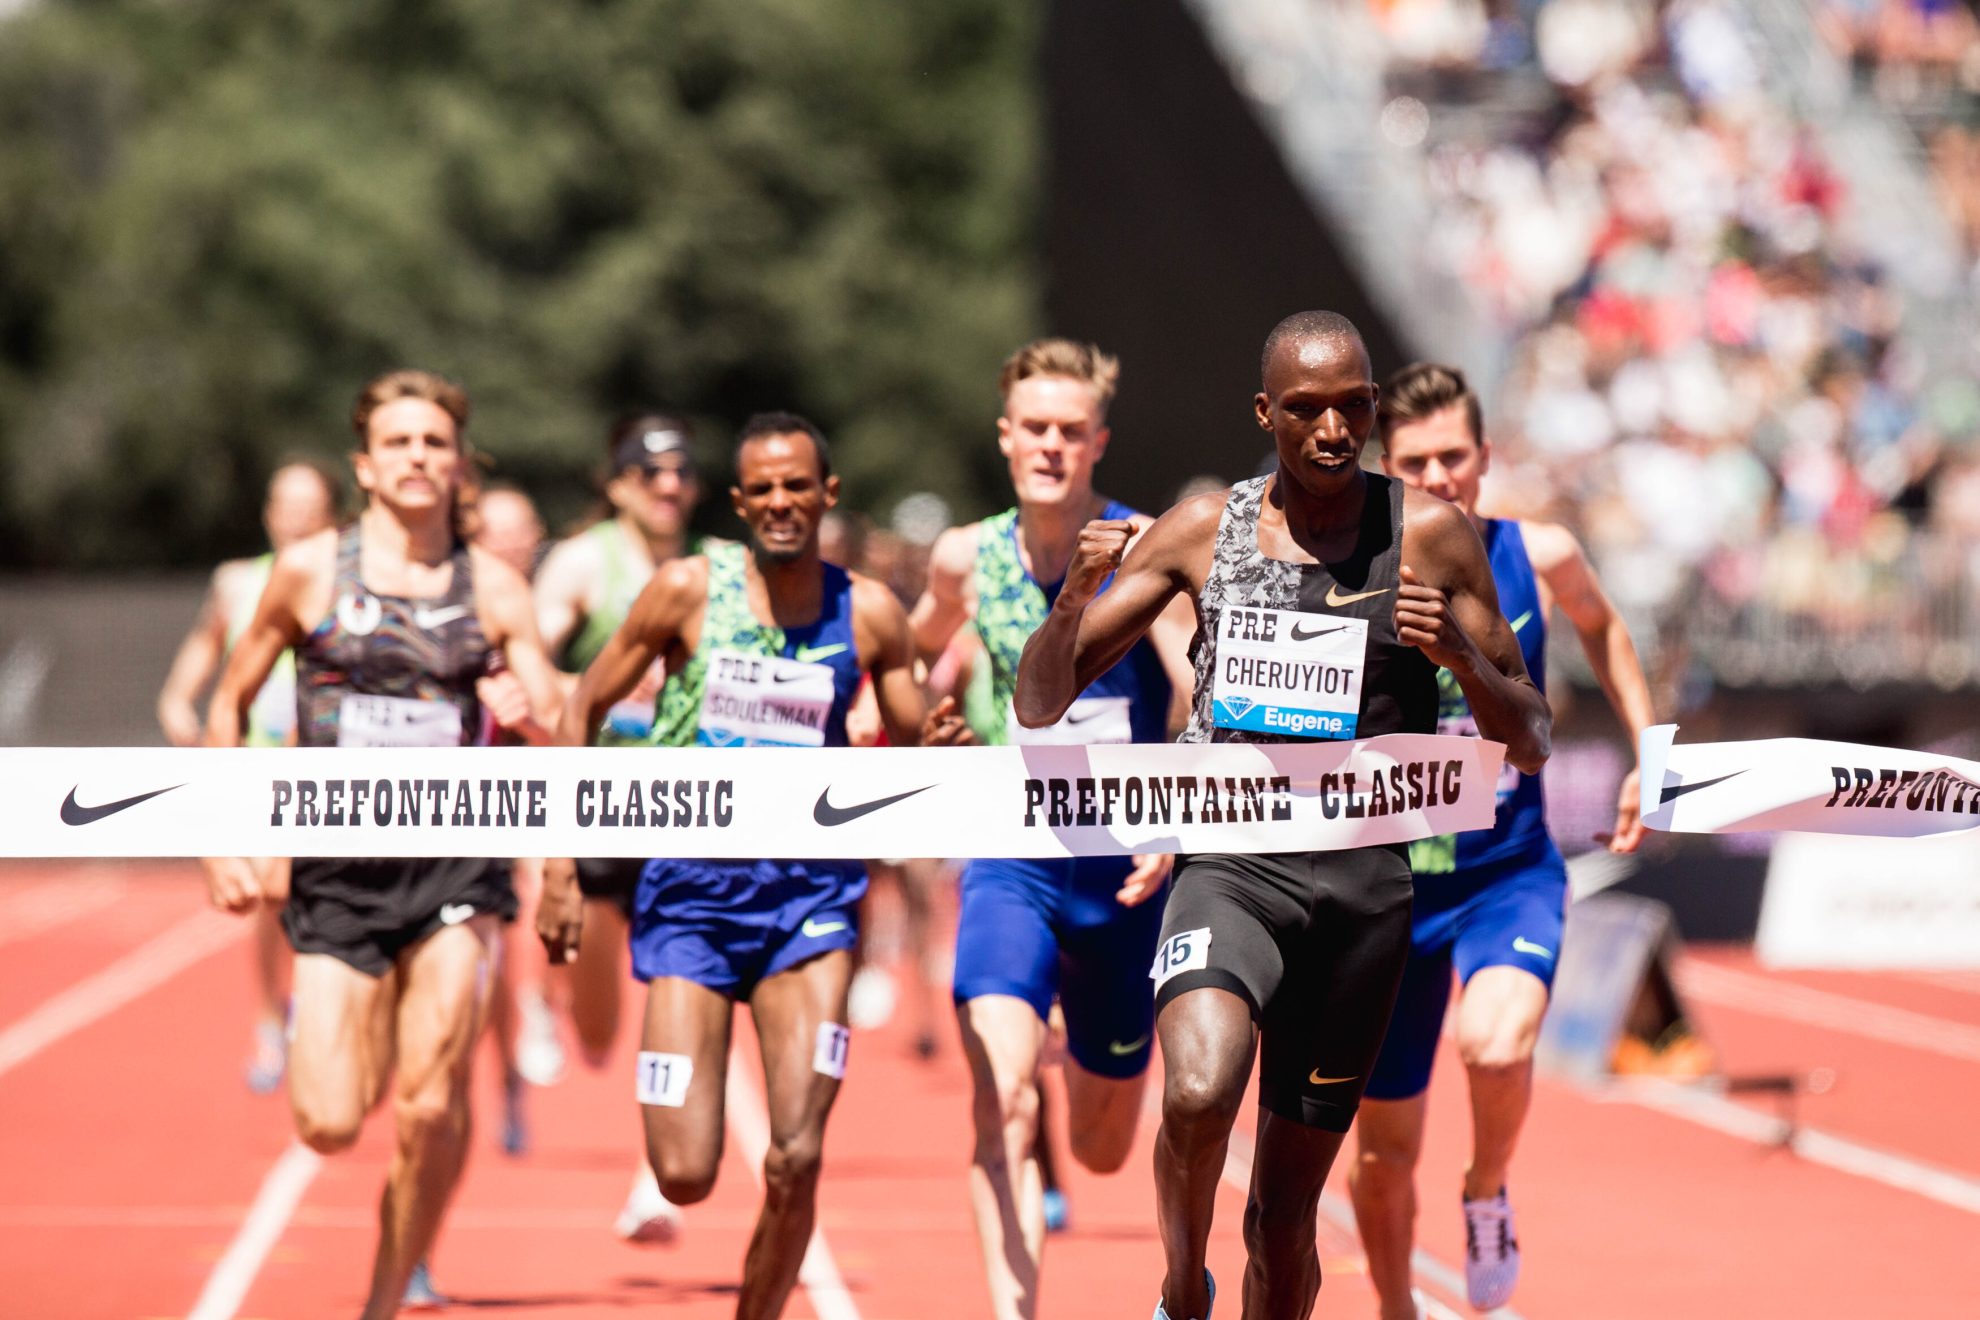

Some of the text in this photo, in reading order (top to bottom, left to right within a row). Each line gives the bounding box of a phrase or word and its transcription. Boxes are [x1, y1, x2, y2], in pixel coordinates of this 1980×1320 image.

[1227, 609, 1278, 643] PRE
[1225, 656, 1354, 696] CHERUYIOT
[1263, 706, 1343, 732] Eugene
[270, 778, 734, 828] PREFONTAINE CLASSIC
[1024, 760, 1463, 827] PREFONTAINE CLASSIC
[1160, 933, 1192, 975] 15
[649, 1058, 671, 1094] 11
